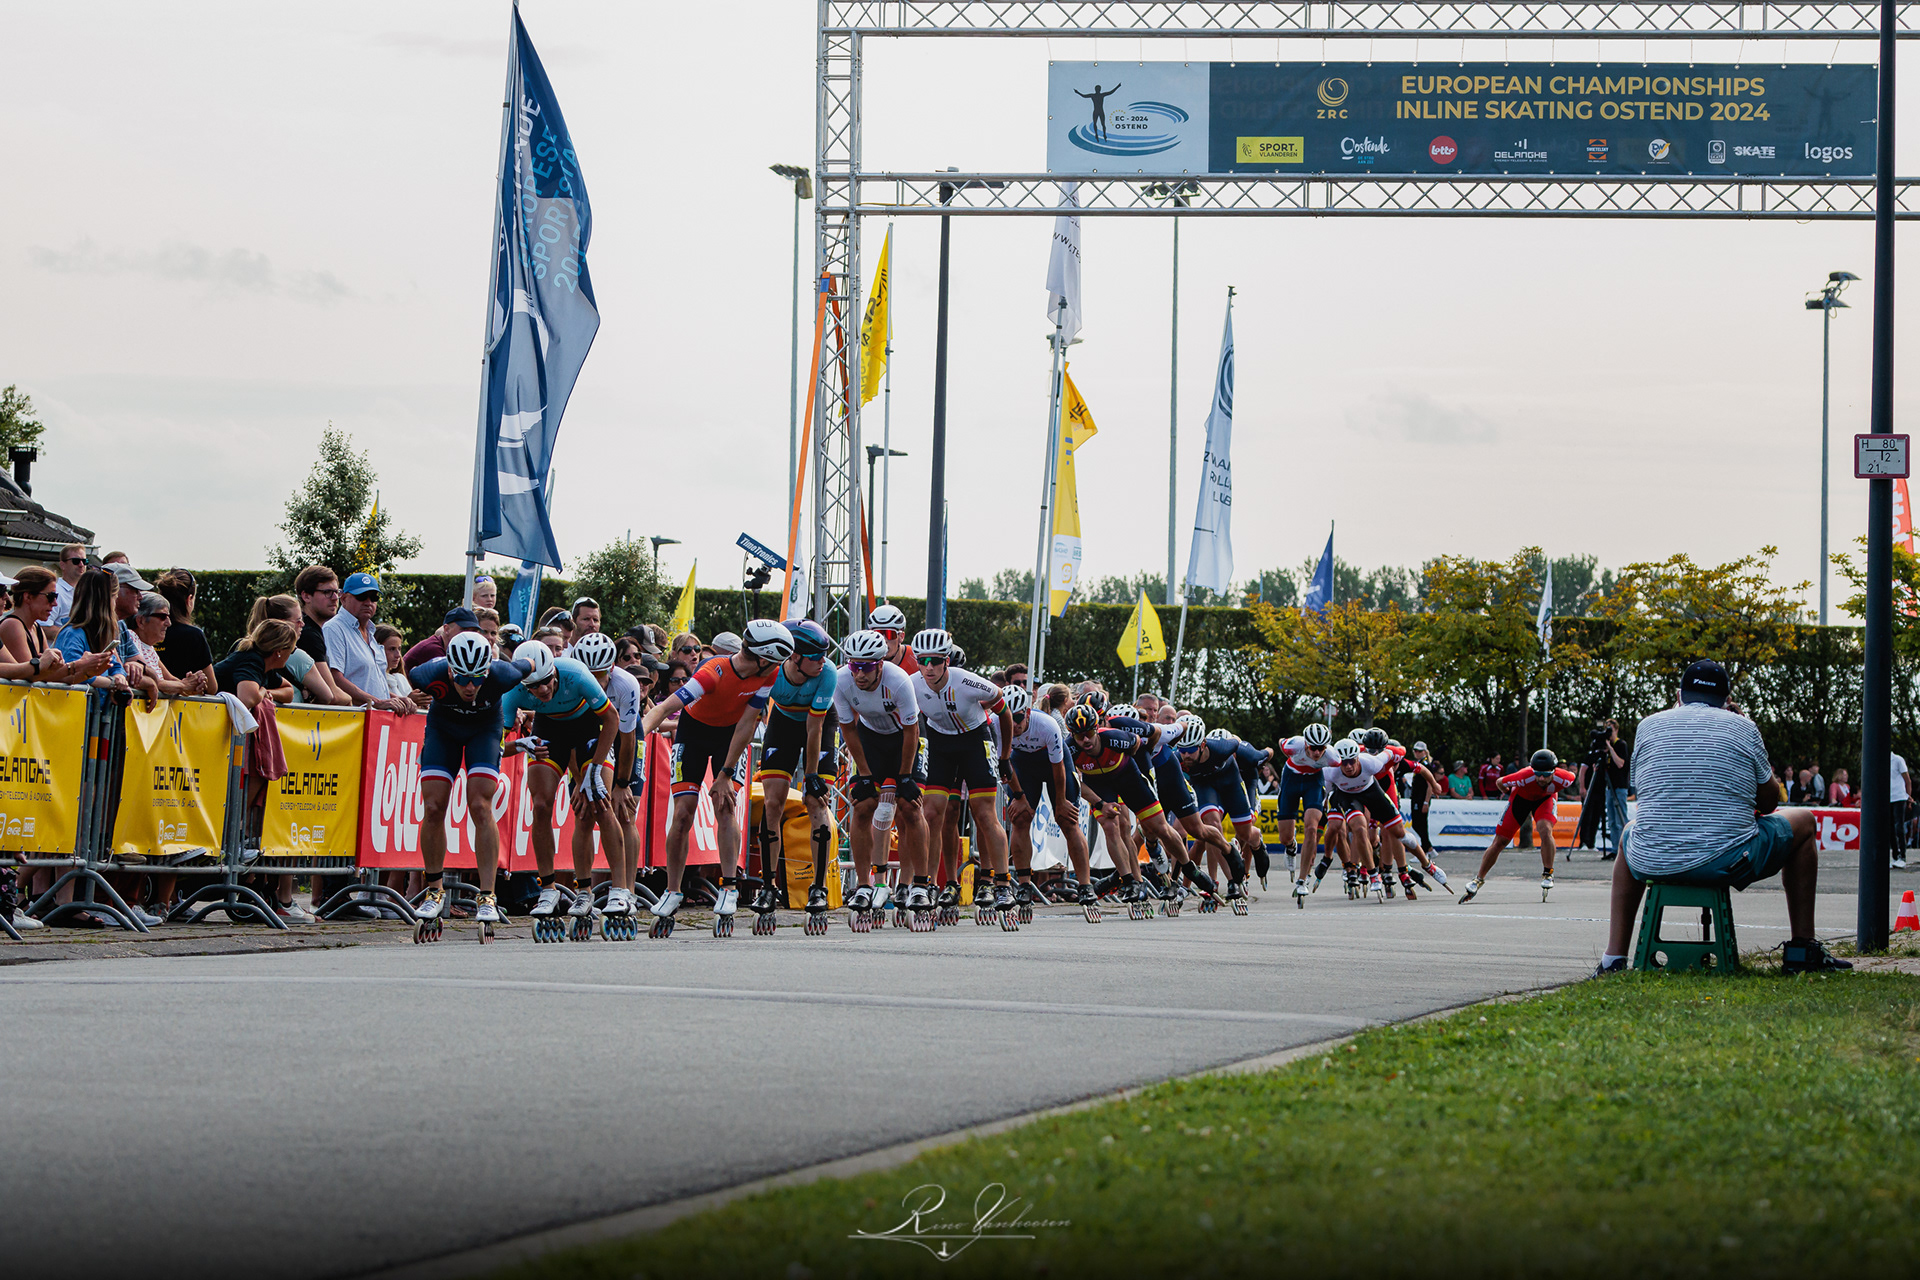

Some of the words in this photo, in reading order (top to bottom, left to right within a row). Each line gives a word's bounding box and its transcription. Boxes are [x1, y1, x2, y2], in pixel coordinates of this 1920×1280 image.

[1401, 75, 1542, 95] EUROPEAN
[1549, 75, 1766, 97] CHAMPIONSHIPS
[1316, 109, 1349, 119] ZRC
[1396, 100, 1478, 119] INLINE
[1485, 100, 1593, 120] SKATING
[1599, 101, 1704, 121] OSTEND
[1710, 102, 1771, 122] 2024
[1259, 143, 1299, 152] SPORT.
[1340, 135, 1391, 156] Oostende
[1494, 151, 1548, 159] DELANGHE
[1734, 146, 1776, 156] SKATE
[1804, 142, 1854, 163] logos
[1861, 439, 1869, 449] H
[1882, 439, 1896, 449] 80
[0, 756, 51, 784] ELANGHE
[153, 766, 200, 792] DELANGHE
[281, 772, 338, 796] DELANGHE
